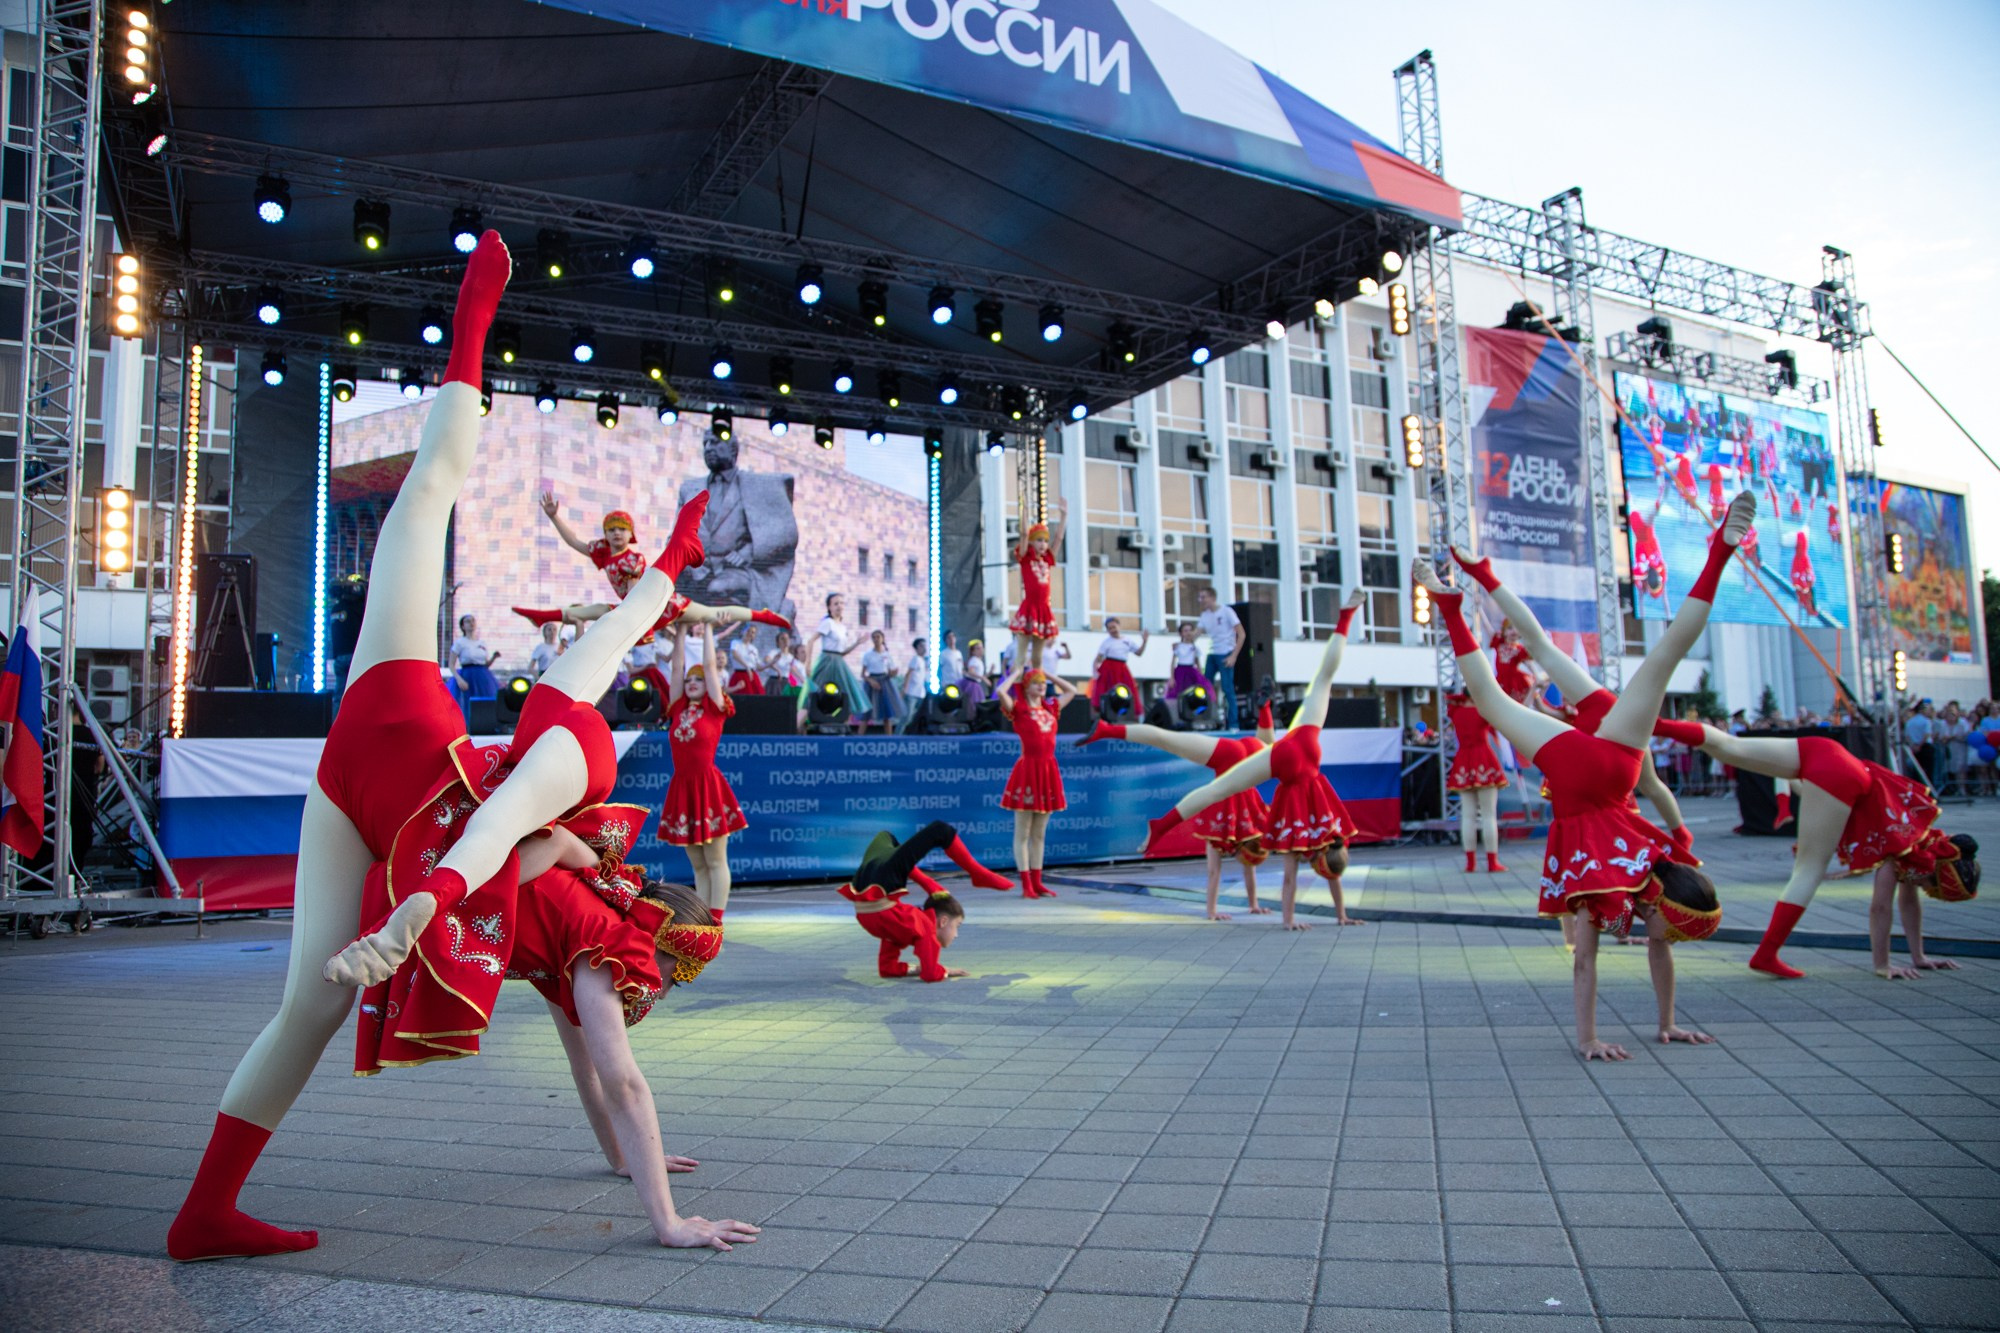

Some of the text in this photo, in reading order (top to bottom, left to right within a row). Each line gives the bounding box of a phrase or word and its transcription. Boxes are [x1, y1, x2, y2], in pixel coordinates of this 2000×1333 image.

[1478, 450, 1566, 487] 12 ДЕНЬ
[1480, 521, 1560, 547] #МыРоссия
[717, 742, 819, 758] ЗДРАВЛЯЕМ
[843, 742, 960, 757] ПОЗДРАВЛЯЕМ
[769, 770, 892, 787] ПОЗДРАВЛЯЕМ
[915, 768, 1012, 784] ПОЗДРАВЛЯЕ
[741, 795, 960, 815] РАВЛЯЕМ ПОЗДРАВЛЯЕМ
[769, 827, 838, 843] ПОЗДРА
[1048, 816, 1116, 832] ПОЗДРАВ
[731, 856, 820, 874] ДРАВЛЯЕМ
